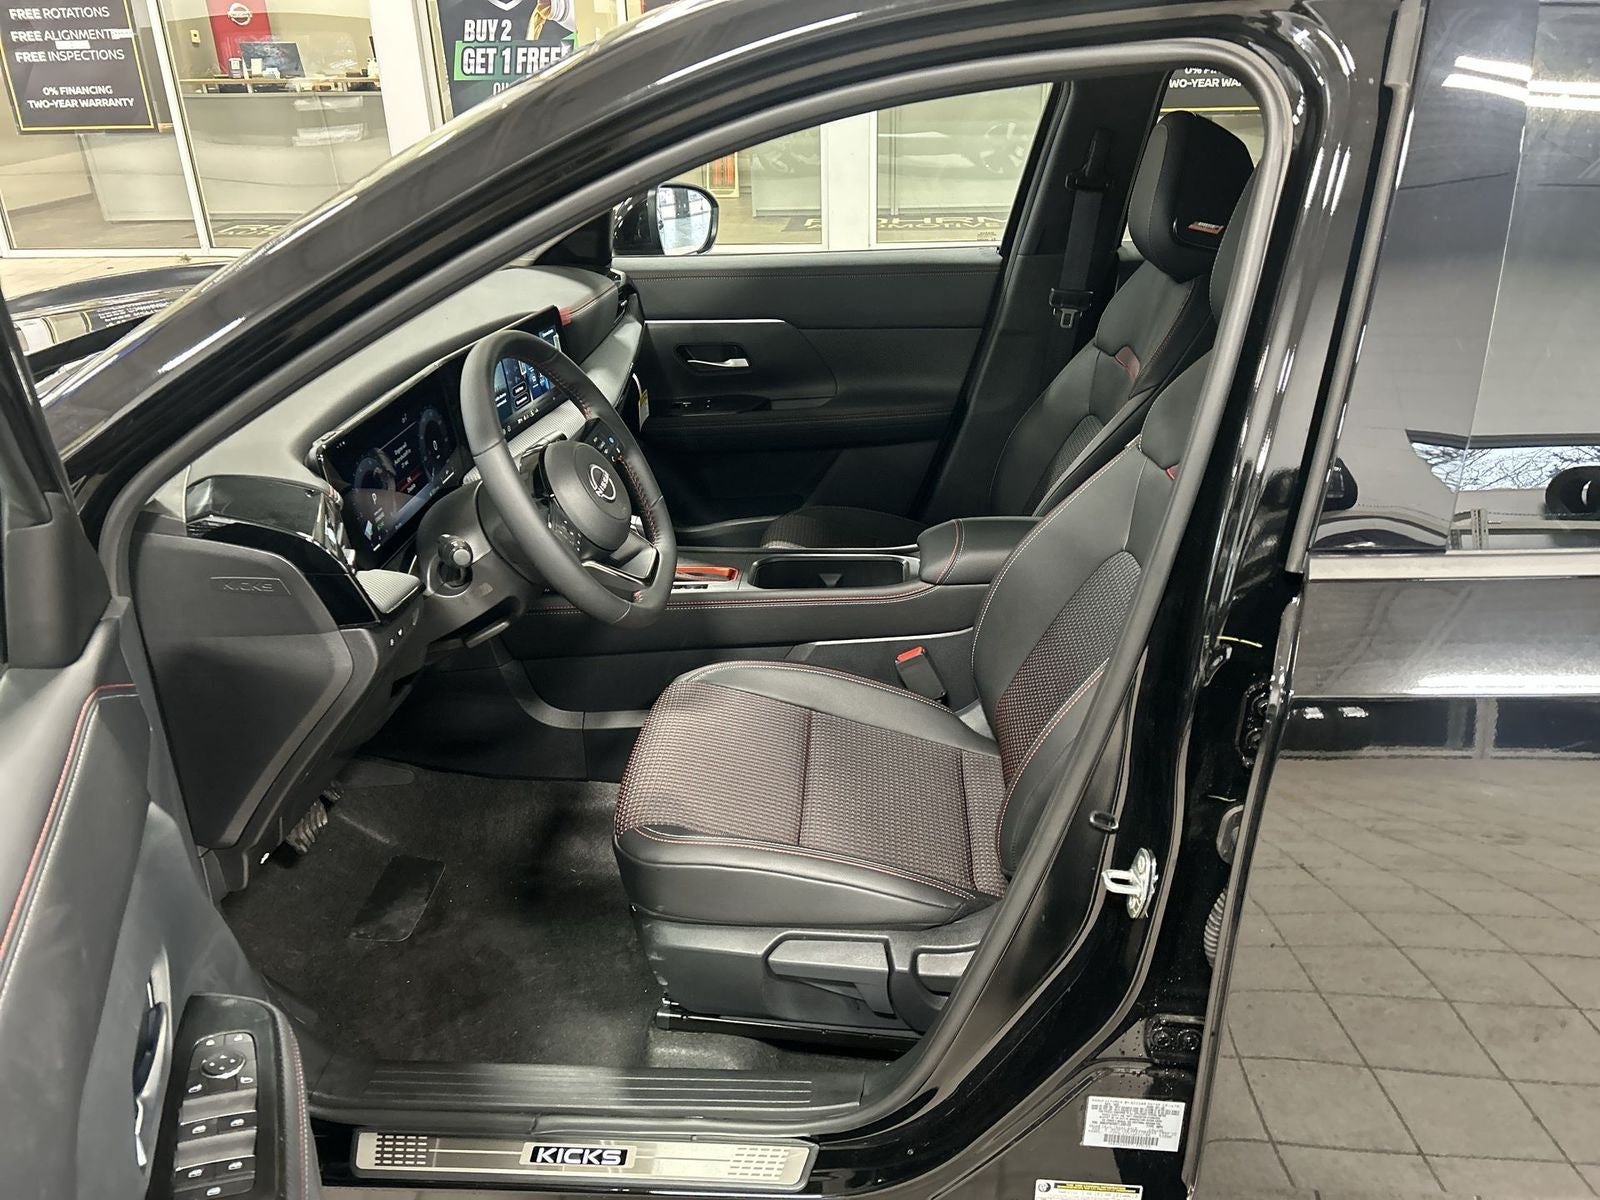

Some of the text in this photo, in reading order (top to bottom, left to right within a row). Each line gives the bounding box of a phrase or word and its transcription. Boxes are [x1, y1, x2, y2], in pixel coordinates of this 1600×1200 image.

[9, 7, 110, 20] FREE ROTATIONS
[10, 31, 43, 42] FREE
[463, 19, 512, 42] BUY 2
[15, 49, 125, 63] FREE INSPECTIONS
[462, 47, 497, 74] GET
[502, 47, 511, 74] 1
[1169, 79, 1219, 88] WO-YEAR
[42, 85, 113, 96] 0% FINANCING
[27, 98, 134, 109] TWO-YEAR WARRANTY
[223, 581, 274, 592] KICKS
[536, 1147, 622, 1165] KICKS
